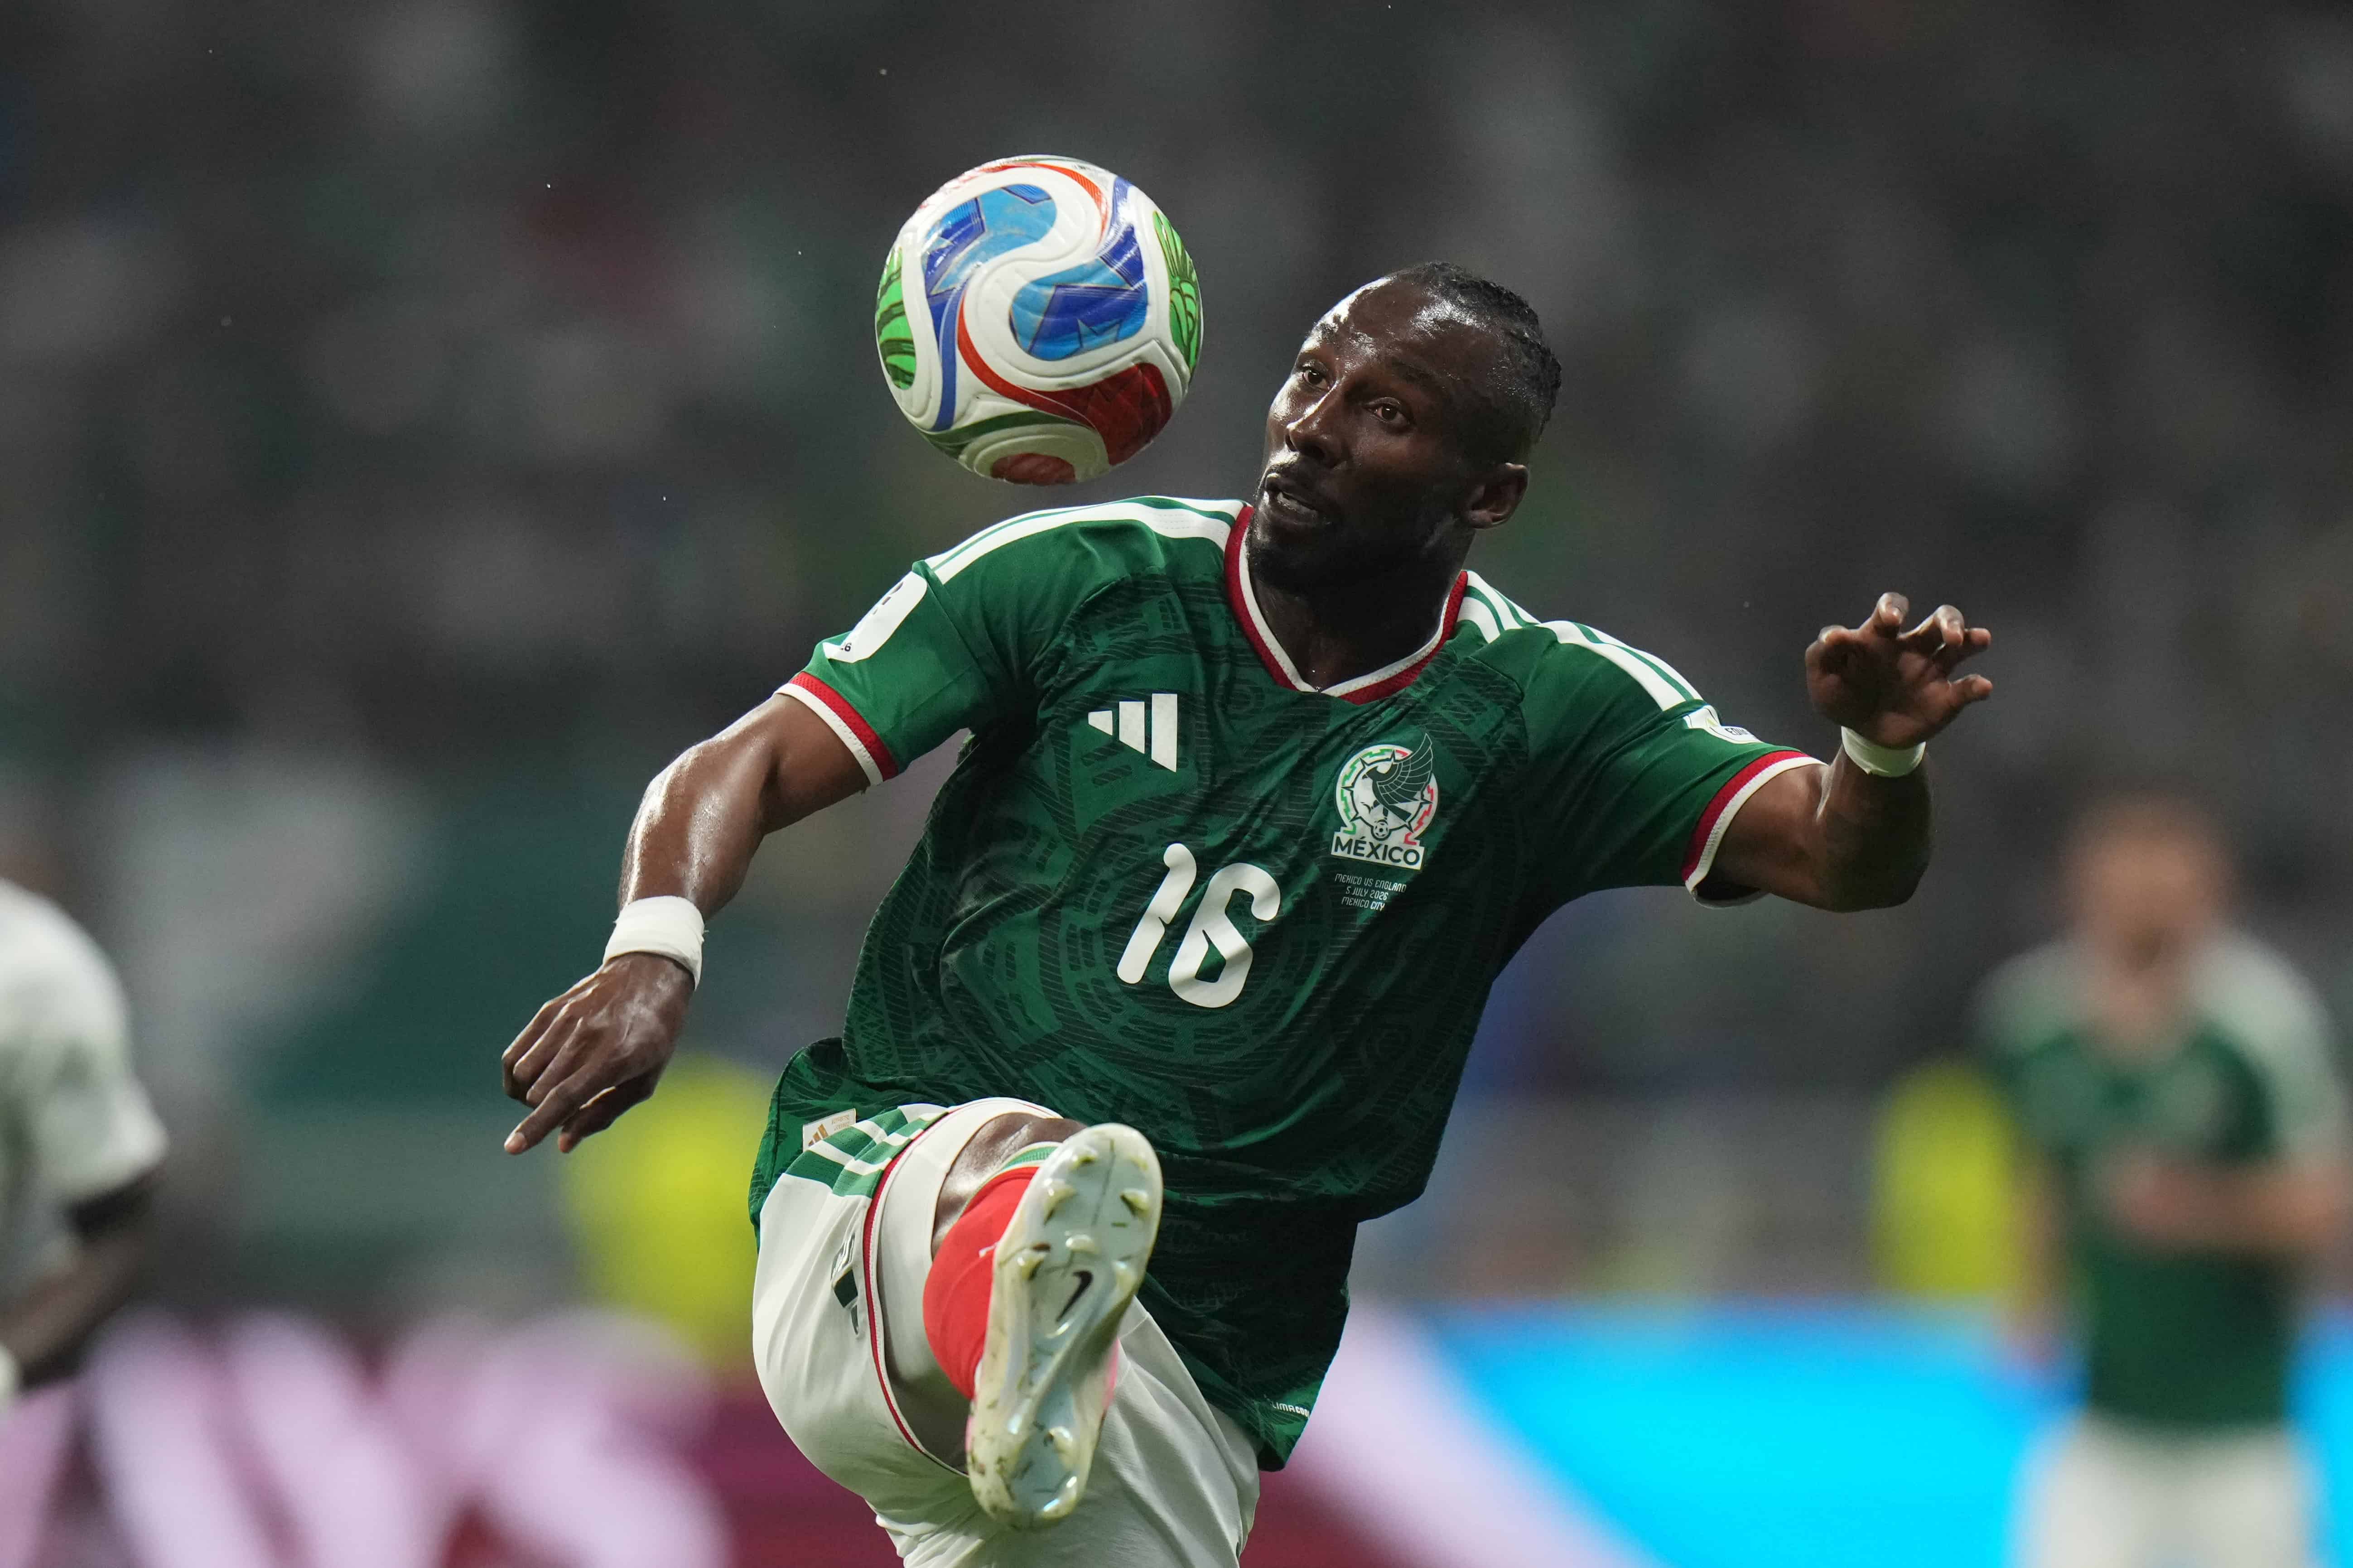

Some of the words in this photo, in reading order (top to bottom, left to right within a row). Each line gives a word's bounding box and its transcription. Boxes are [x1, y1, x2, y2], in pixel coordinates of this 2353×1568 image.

[1334, 836, 1420, 866] MÉXICO
[1335, 873, 1362, 885] MEXICO
[1375, 880, 1407, 892] ENGLAND
[1345, 886, 1351, 895] 5
[1352, 887, 1369, 897] JULY
[1370, 890, 1389, 900] 2026
[1341, 896, 1369, 908] MEXICO
[1370, 901, 1385, 911] CITY
[1117, 843, 1281, 1008] 16
